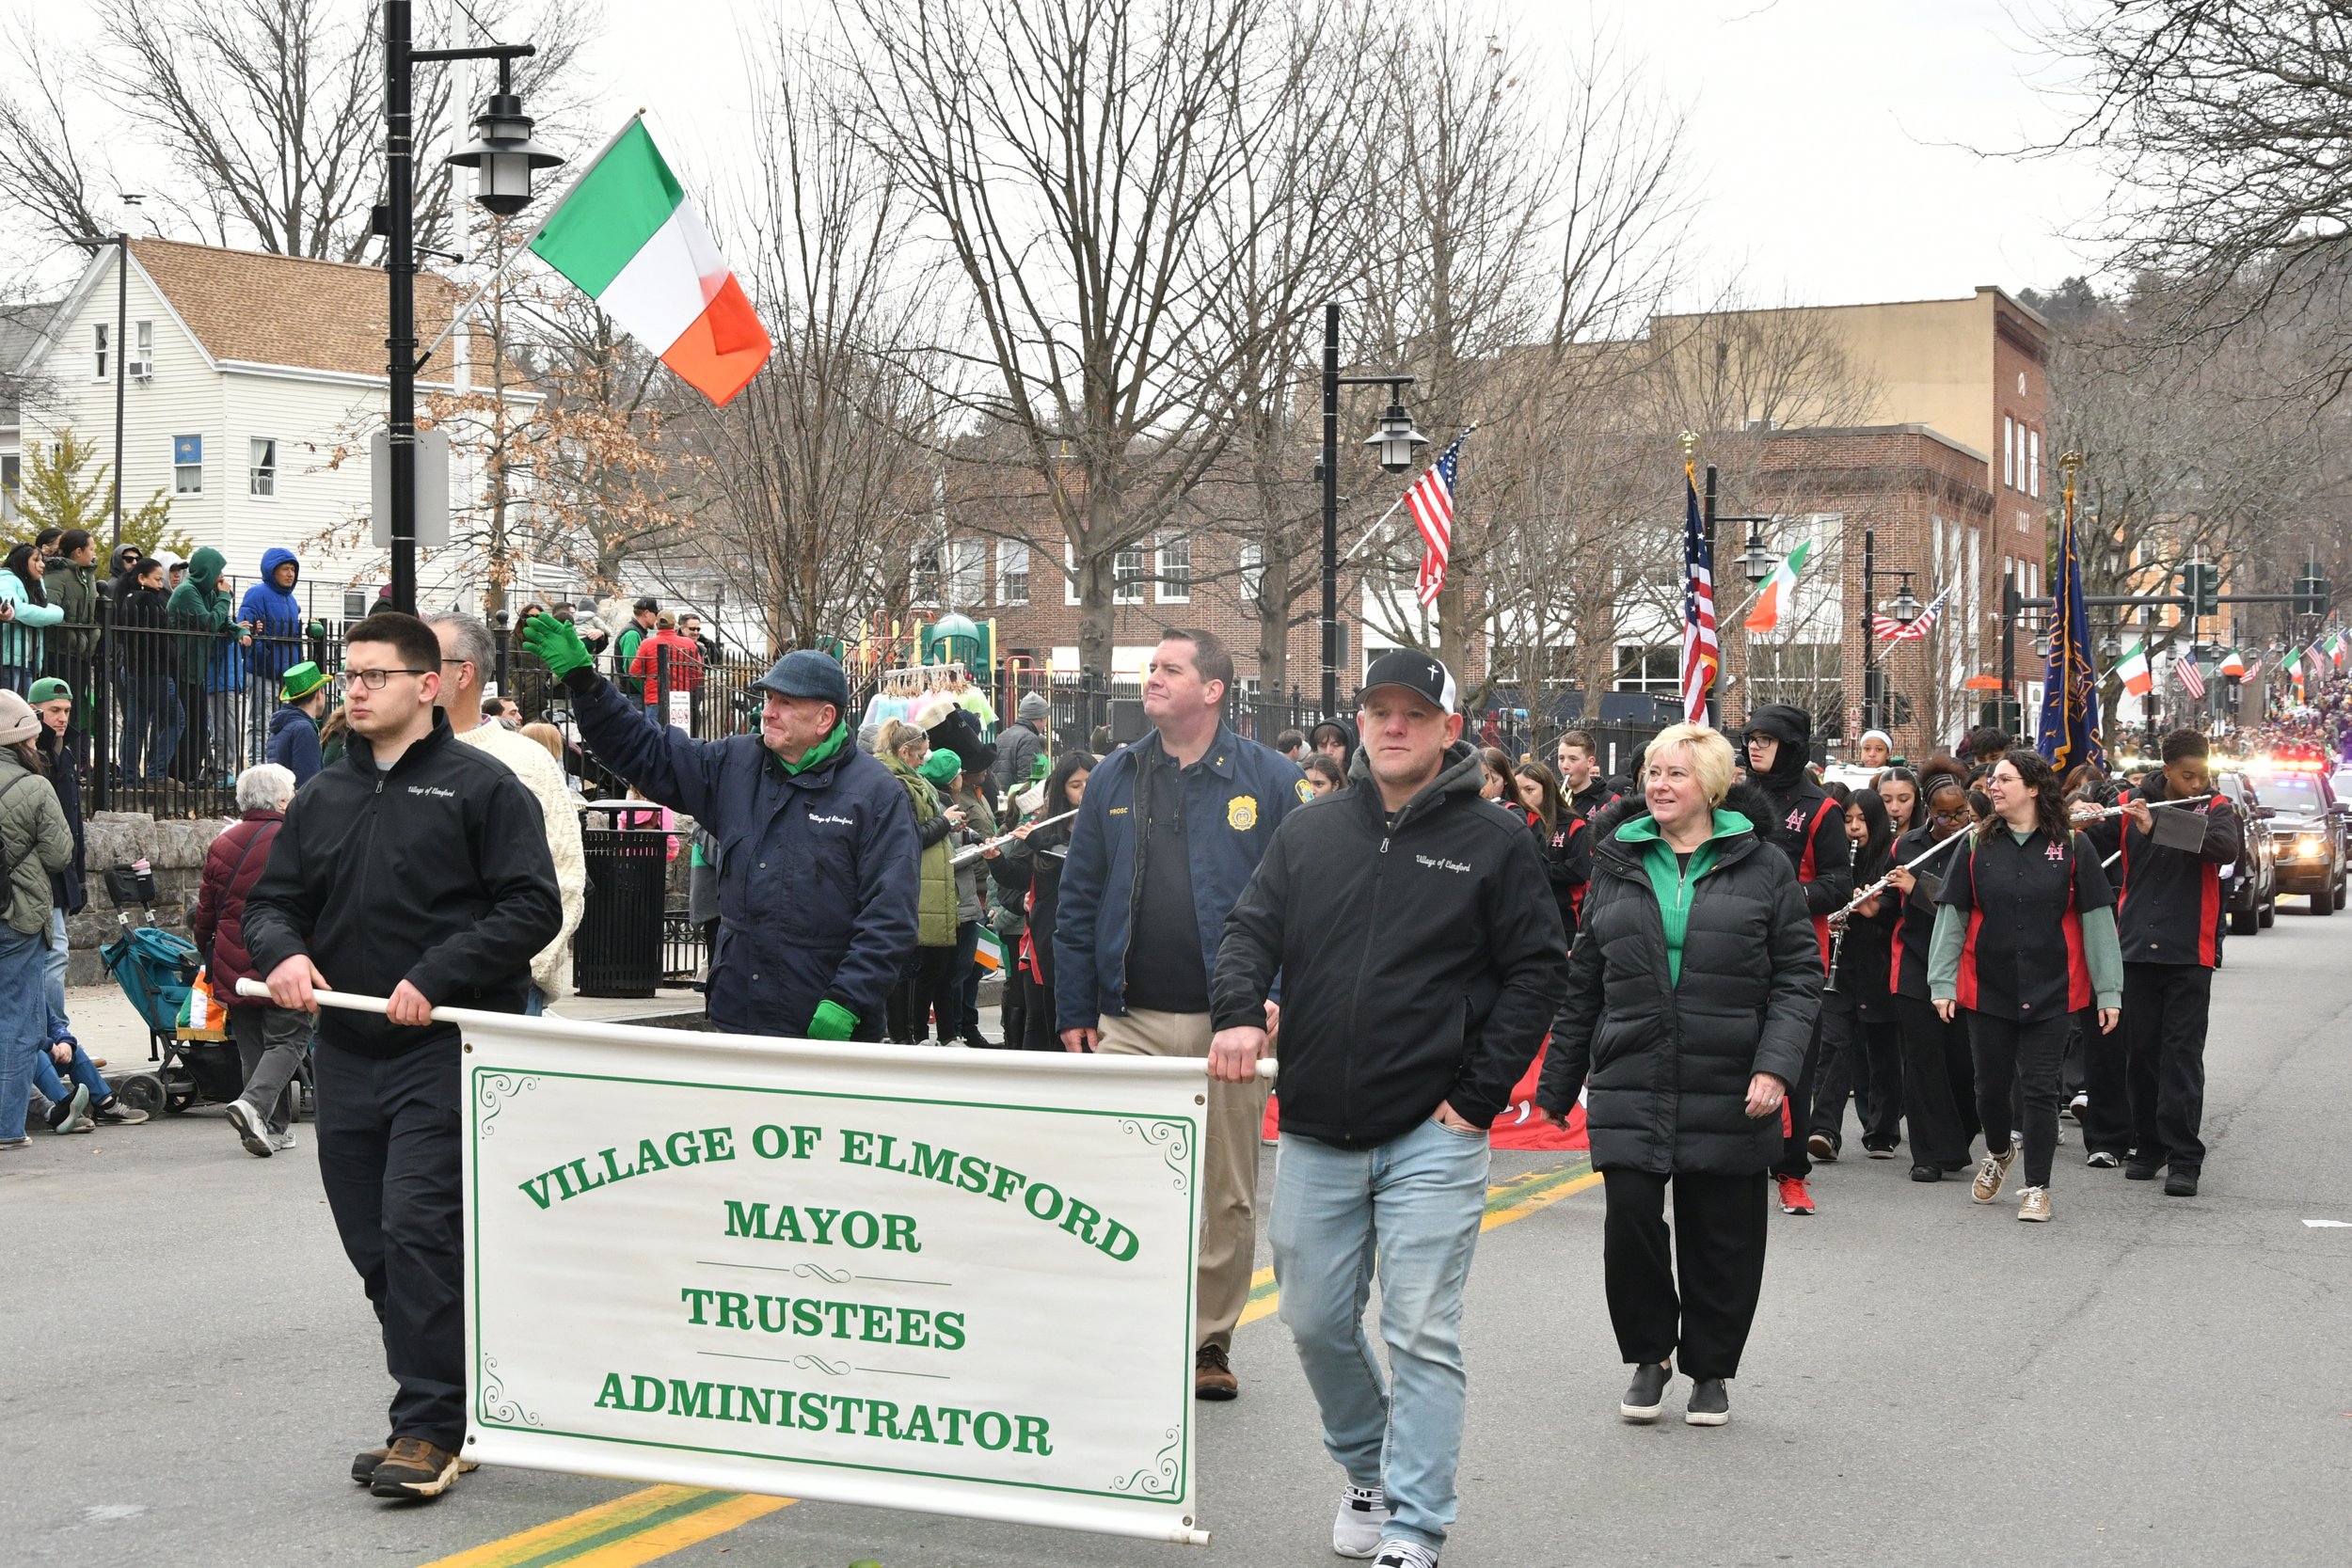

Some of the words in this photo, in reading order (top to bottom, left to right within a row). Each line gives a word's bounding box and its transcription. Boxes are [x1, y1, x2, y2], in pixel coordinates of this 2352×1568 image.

[1416, 854, 1437, 868] Village
[1437, 858, 1446, 870] of
[1445, 860, 1471, 874] Elmsford
[519, 1126, 737, 1210] VILLAGE
[753, 1124, 823, 1160] OF
[839, 1129, 1139, 1262] ELMSFORD
[723, 1200, 922, 1253] MAYOR
[681, 1288, 967, 1351] TRUSTEES
[595, 1372, 1054, 1457] ADMINISTRATOR
